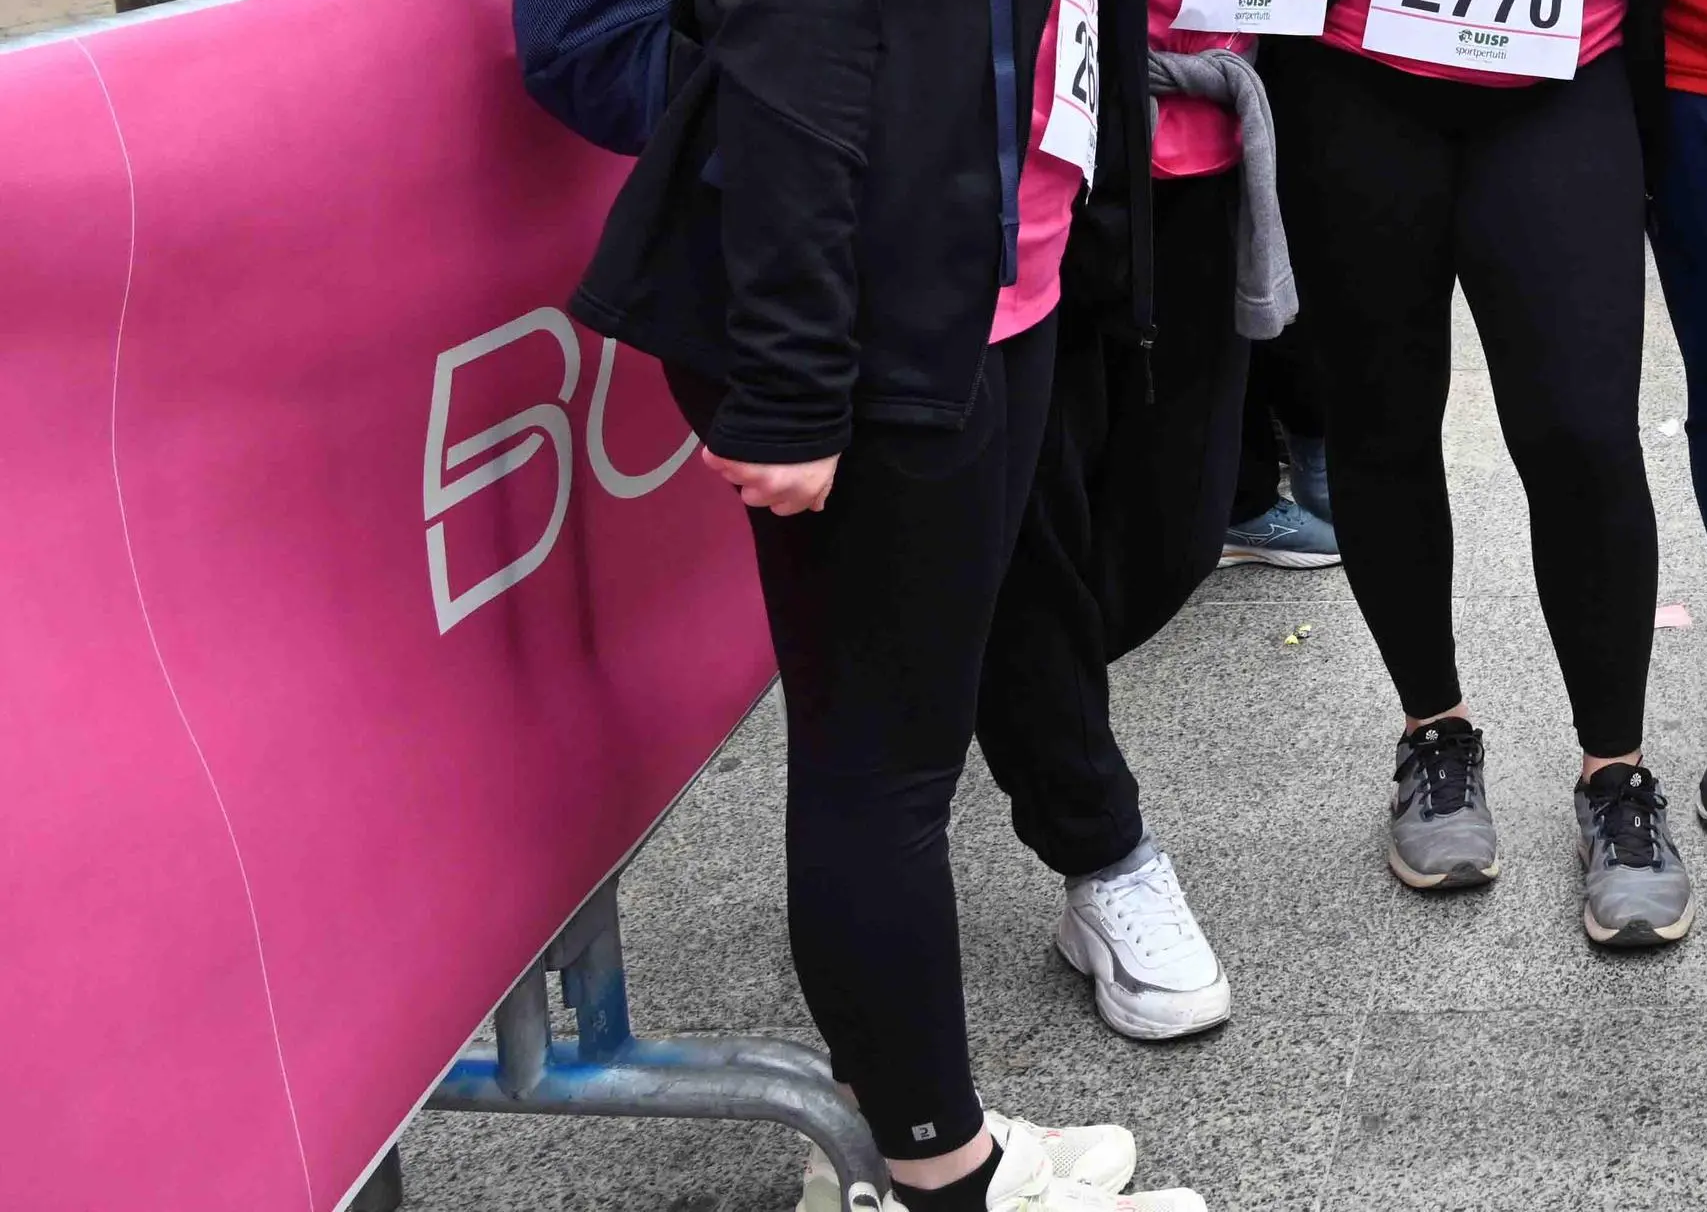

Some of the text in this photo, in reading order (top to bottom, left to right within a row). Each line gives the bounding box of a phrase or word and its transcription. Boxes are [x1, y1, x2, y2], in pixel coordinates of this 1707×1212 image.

[1474, 32, 1510, 47] UISP
[1455, 46, 1507, 60] sportpertutti
[1071, 20, 1099, 115] 26
